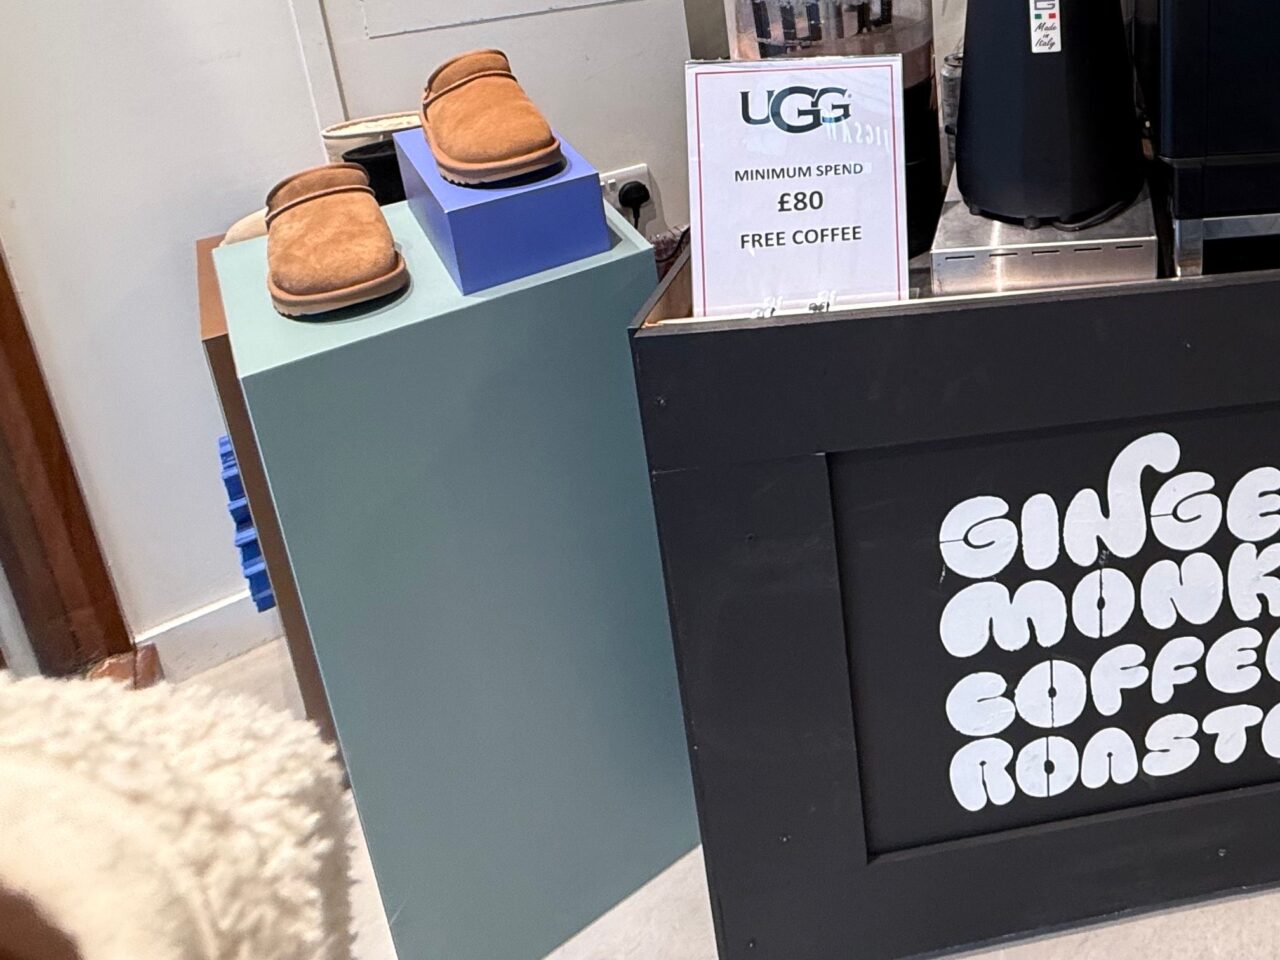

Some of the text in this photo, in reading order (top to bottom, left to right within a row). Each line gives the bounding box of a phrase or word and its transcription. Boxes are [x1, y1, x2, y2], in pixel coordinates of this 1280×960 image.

[1034, 22, 1057, 33] Made
[1035, 37, 1056, 50] Italy
[740, 86, 851, 134] UGG
[735, 163, 864, 182] MINIMUM SPEND
[777, 190, 824, 212] £80
[740, 225, 862, 249] FREE COFFEE
